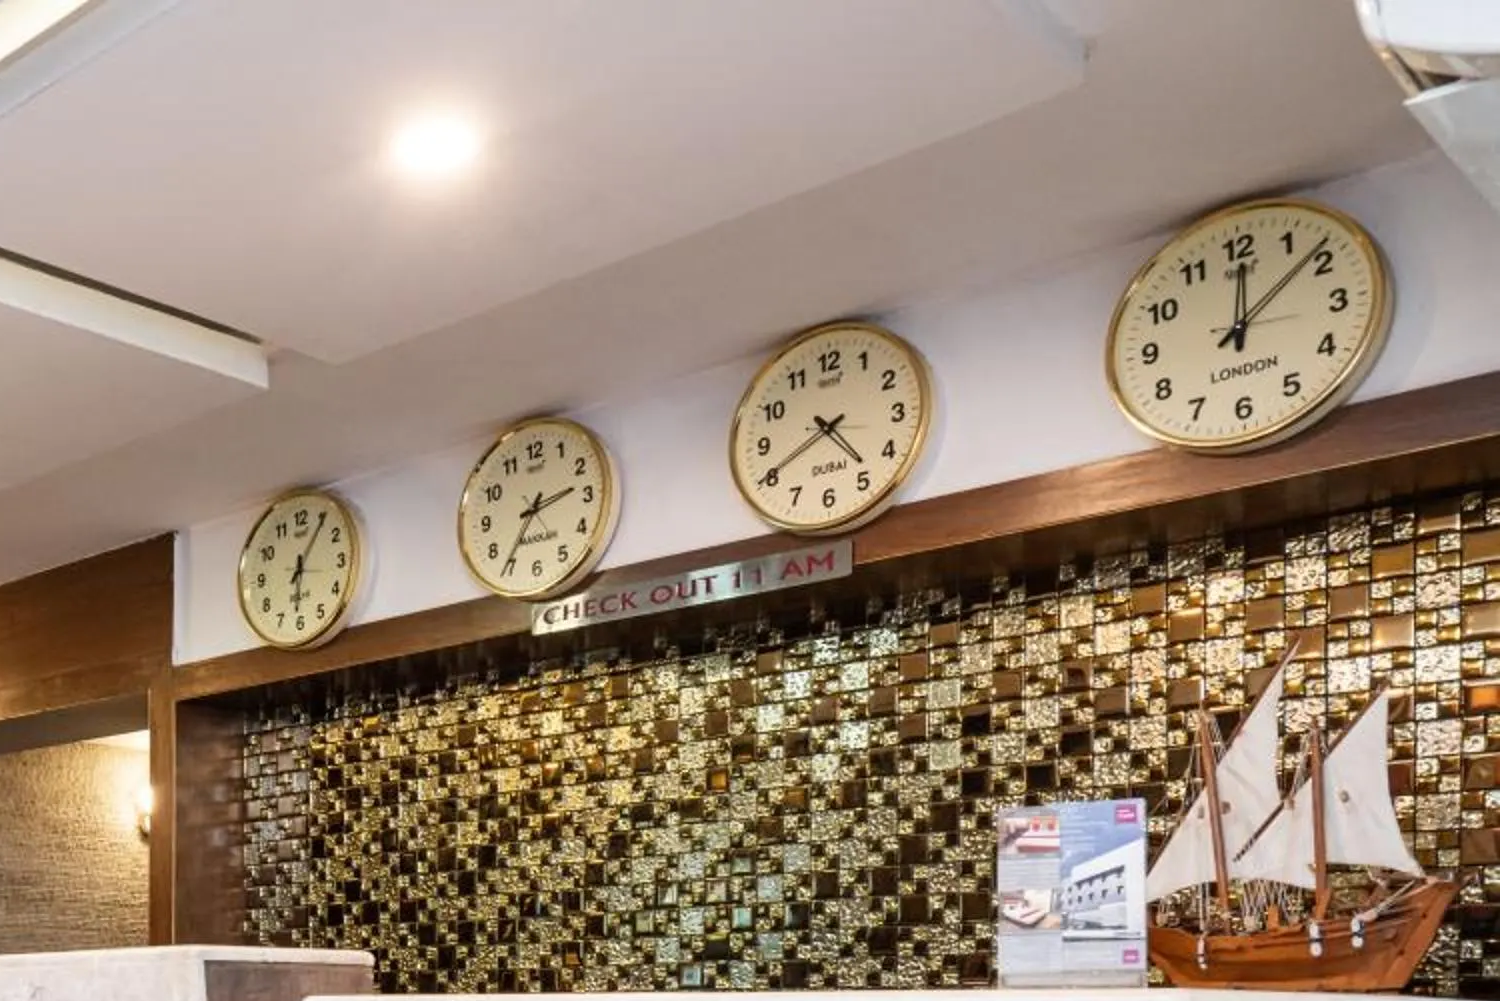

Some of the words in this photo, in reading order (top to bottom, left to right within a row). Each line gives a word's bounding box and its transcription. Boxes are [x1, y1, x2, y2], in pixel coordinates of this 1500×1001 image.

[1223, 234, 1254, 261] 12
[1280, 232, 1293, 254] 1
[1180, 260, 1206, 285] 11
[1314, 250, 1333, 276] 2
[1329, 288, 1348, 312] 3
[1147, 298, 1178, 325] 10
[1141, 343, 1159, 365] 9
[1317, 333, 1337, 357] 4
[818, 351, 840, 373] 12
[857, 351, 869, 370] 1
[1210, 355, 1279, 384] LONDON
[787, 370, 806, 390] 11
[881, 370, 896, 391] 2
[1155, 377, 1172, 400] 8
[1282, 372, 1301, 396] 5
[764, 400, 785, 422] 10
[891, 403, 905, 422] 3
[1188, 397, 1206, 422] 7
[1235, 396, 1253, 420] 6
[526, 441, 543, 460] 12
[555, 442, 565, 458] 1
[757, 437, 771, 456] 9
[881, 439, 896, 459] 4
[503, 458, 517, 475] 11
[575, 457, 585, 475] 2
[811, 459, 847, 477] DUBAI
[766, 468, 779, 487] 8
[857, 472, 870, 491] 5
[485, 483, 502, 503] 10
[583, 486, 593, 502] 3
[789, 487, 802, 507] 7
[822, 488, 835, 508] 6
[294, 509, 308, 526] 12
[481, 515, 491, 532] 9
[576, 518, 586, 535] 4
[276, 523, 287, 538] 11
[332, 528, 340, 543] 2
[261, 545, 275, 561] 10
[337, 552, 345, 568] 3
[488, 543, 498, 559] 8
[558, 545, 568, 562] 5
[507, 558, 516, 576] 7
[532, 559, 542, 576] 6
[257, 574, 265, 588] 9
[332, 580, 339, 595] 4
[542, 591, 639, 625] CHECK
[649, 574, 717, 605] OUT
[780, 550, 834, 580] AM
[263, 597, 271, 612] 8
[316, 604, 325, 619] 5
[276, 613, 285, 628] 7
[296, 616, 305, 630] 6
